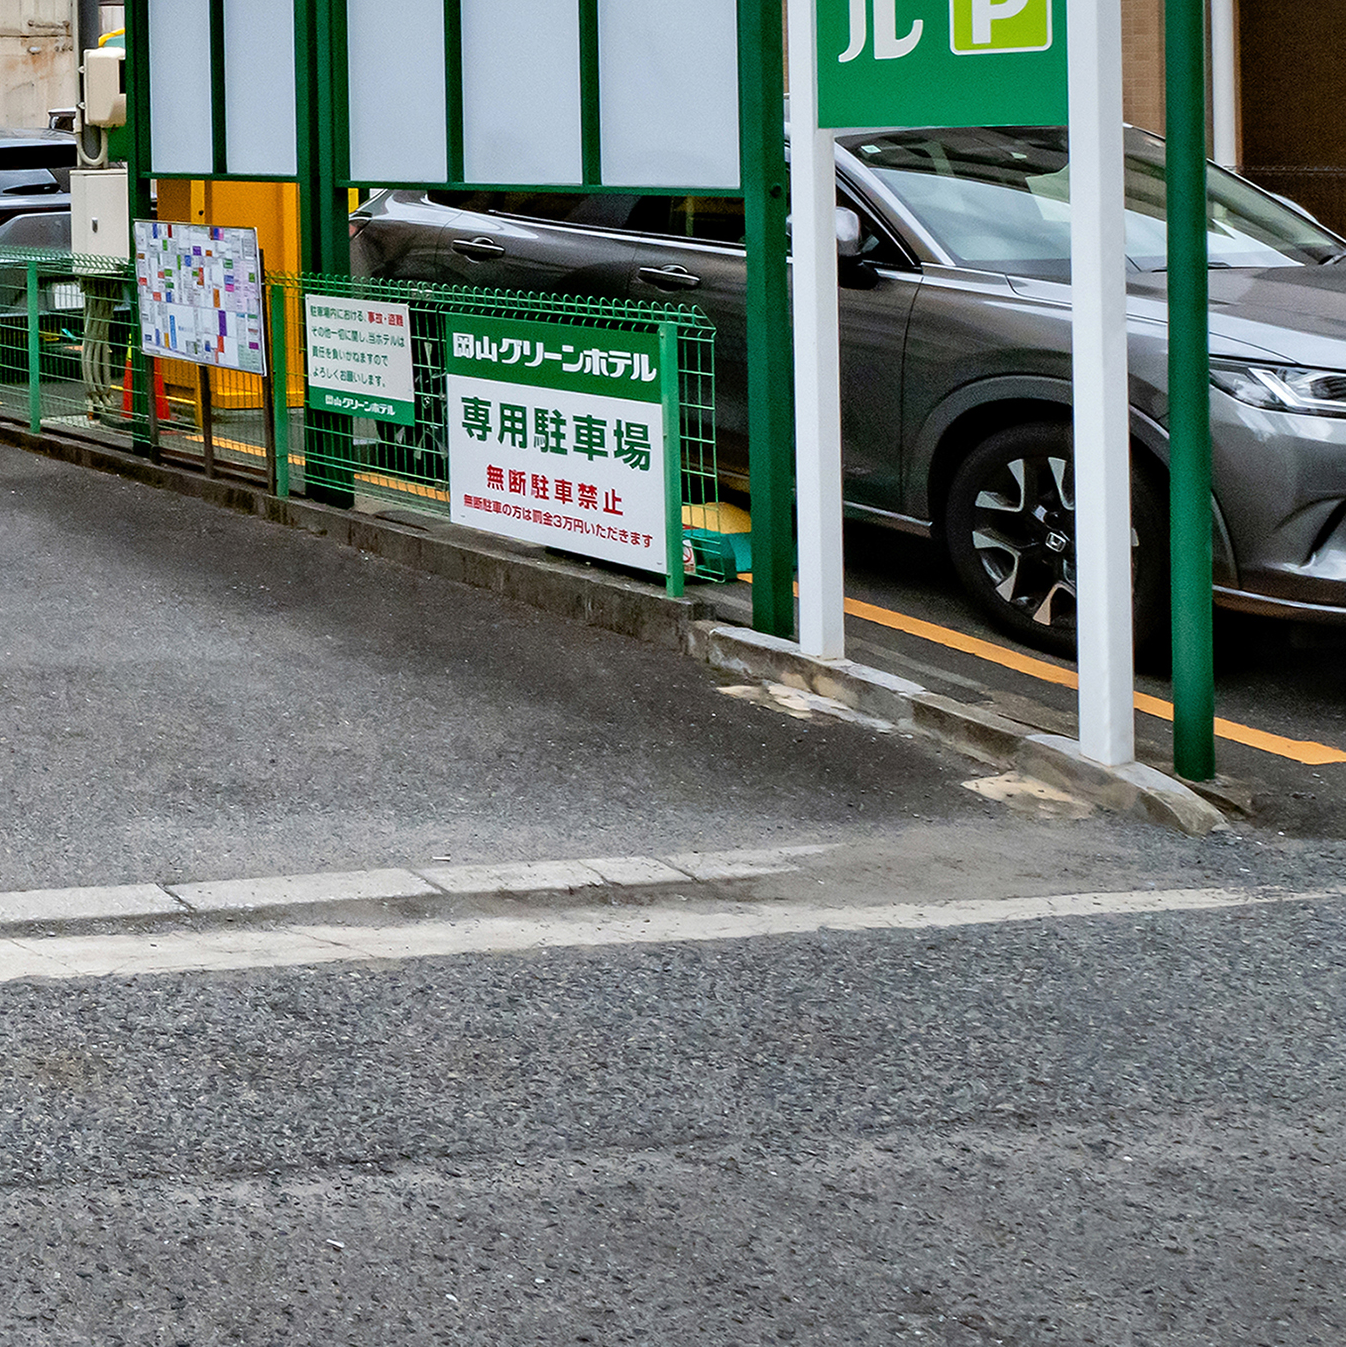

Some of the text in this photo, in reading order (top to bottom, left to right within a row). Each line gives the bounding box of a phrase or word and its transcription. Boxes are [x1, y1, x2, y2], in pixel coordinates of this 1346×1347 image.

[452, 332, 657, 382] 岡山グリーンホテル
[325, 394, 396, 416] 岡山グリーンホテル
[461, 396, 652, 472] 専用駐車場
[486, 464, 624, 517] 無断駐車禁止
[463, 493, 654, 549] 無断駐車の方は罰金3万円いただきます
